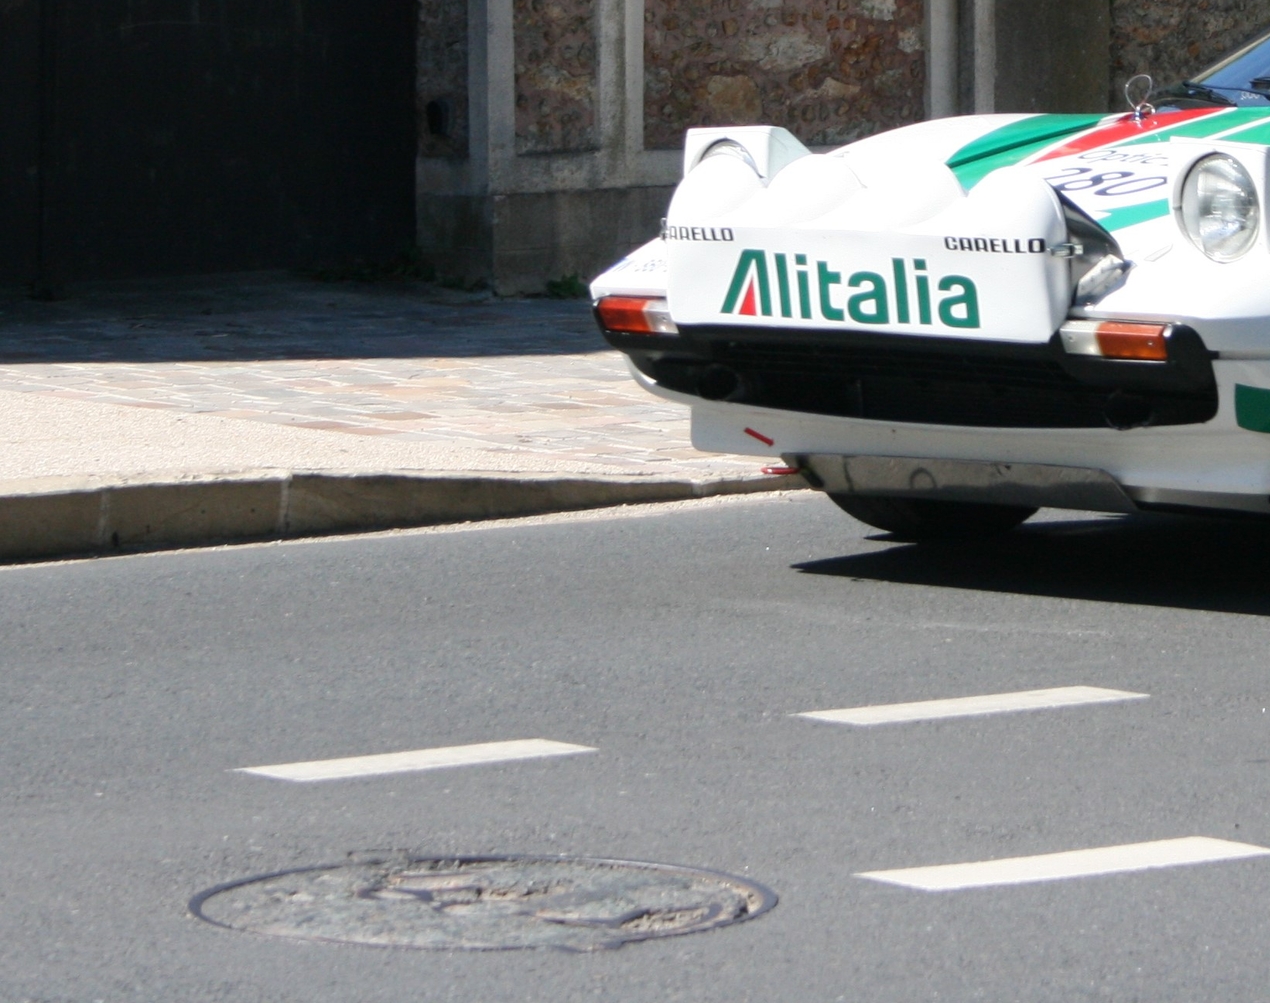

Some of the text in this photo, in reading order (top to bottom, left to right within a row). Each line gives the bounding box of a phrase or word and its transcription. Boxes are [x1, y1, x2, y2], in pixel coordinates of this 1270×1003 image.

[667, 225, 734, 242] ARELLO
[944, 235, 1045, 254] CARELLO
[720, 248, 981, 329] Alitalia
